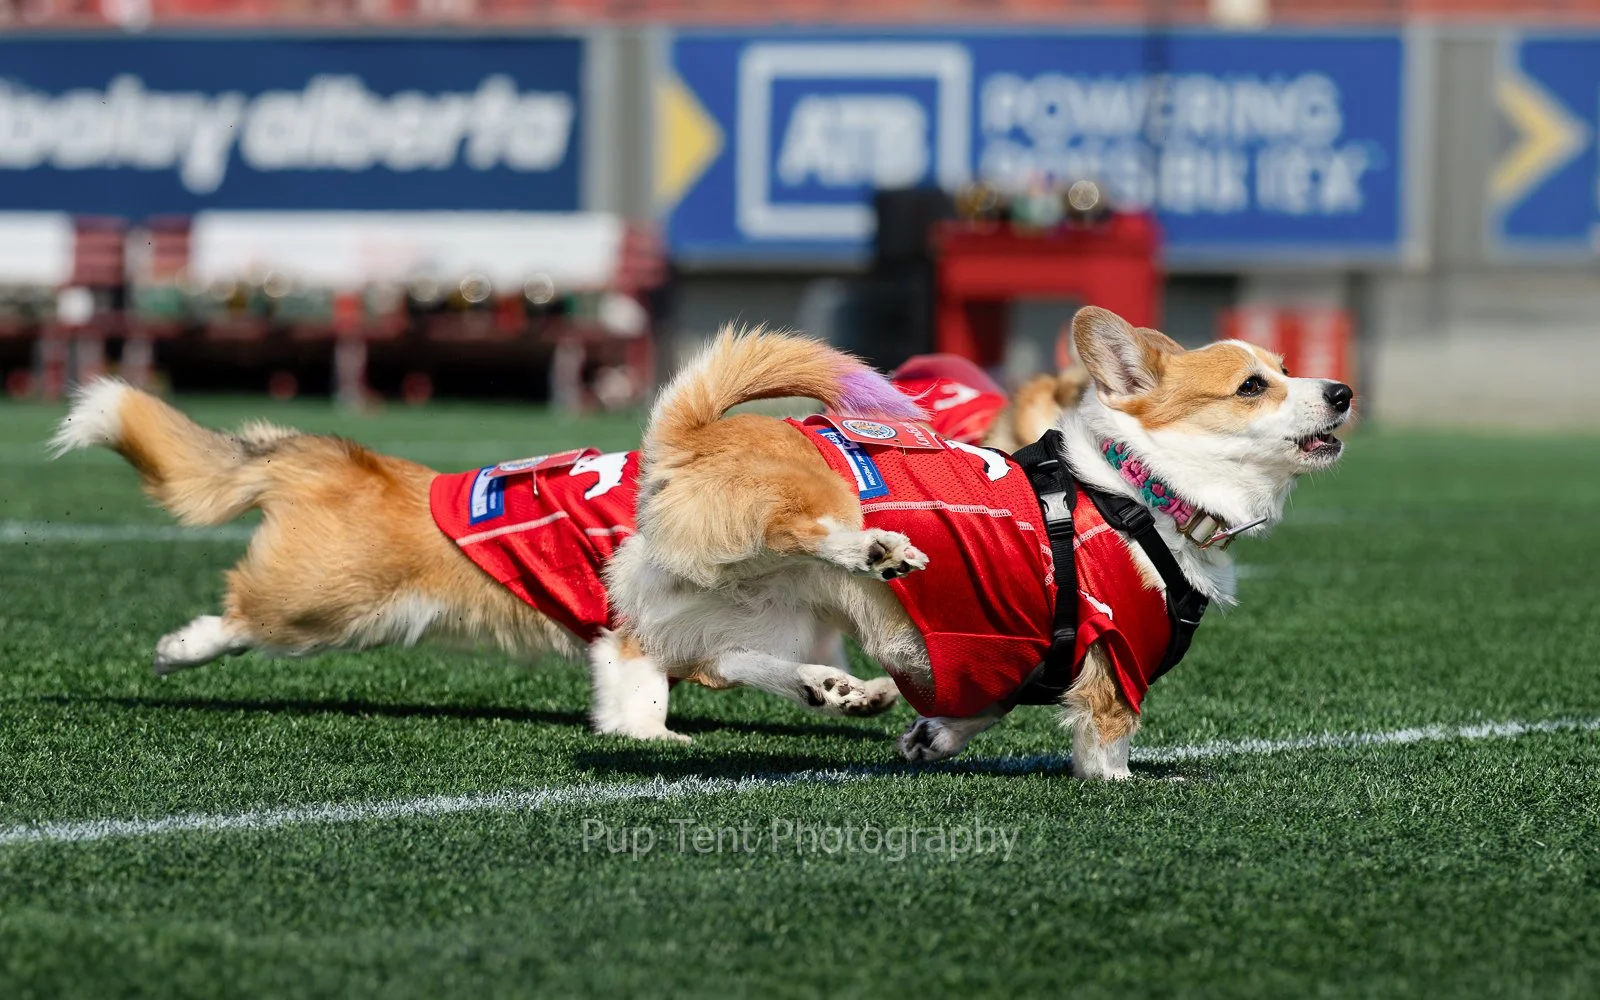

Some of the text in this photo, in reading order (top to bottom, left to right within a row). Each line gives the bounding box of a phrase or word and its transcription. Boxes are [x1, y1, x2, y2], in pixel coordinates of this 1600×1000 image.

[242, 74, 573, 170] alberta
[778, 94, 929, 187] ATB
[980, 74, 1342, 146] POWERING
